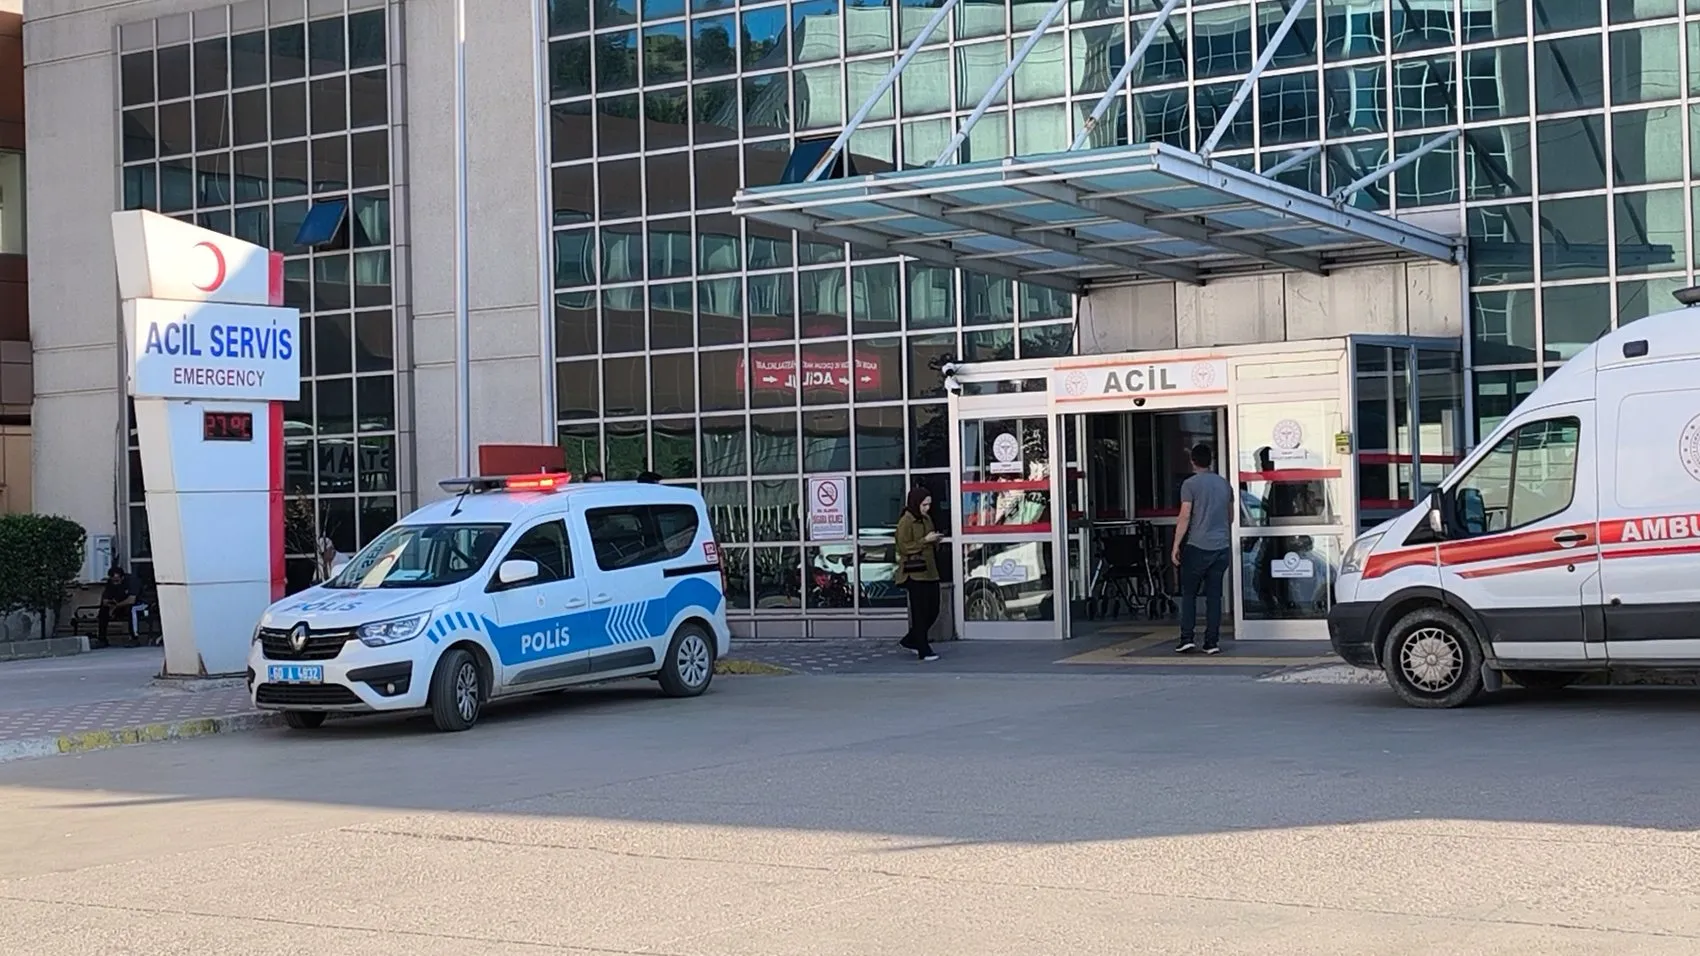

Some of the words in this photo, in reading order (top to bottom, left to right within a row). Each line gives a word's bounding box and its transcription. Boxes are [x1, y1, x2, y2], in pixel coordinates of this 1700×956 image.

[145, 314, 202, 356] ACİL
[210, 319, 292, 360] SERVİS
[173, 367, 265, 387] EMERGENCY
[1103, 366, 1177, 394] ACİL
[1621, 516, 1700, 541] AMBU
[521, 622, 570, 655] POLİS
